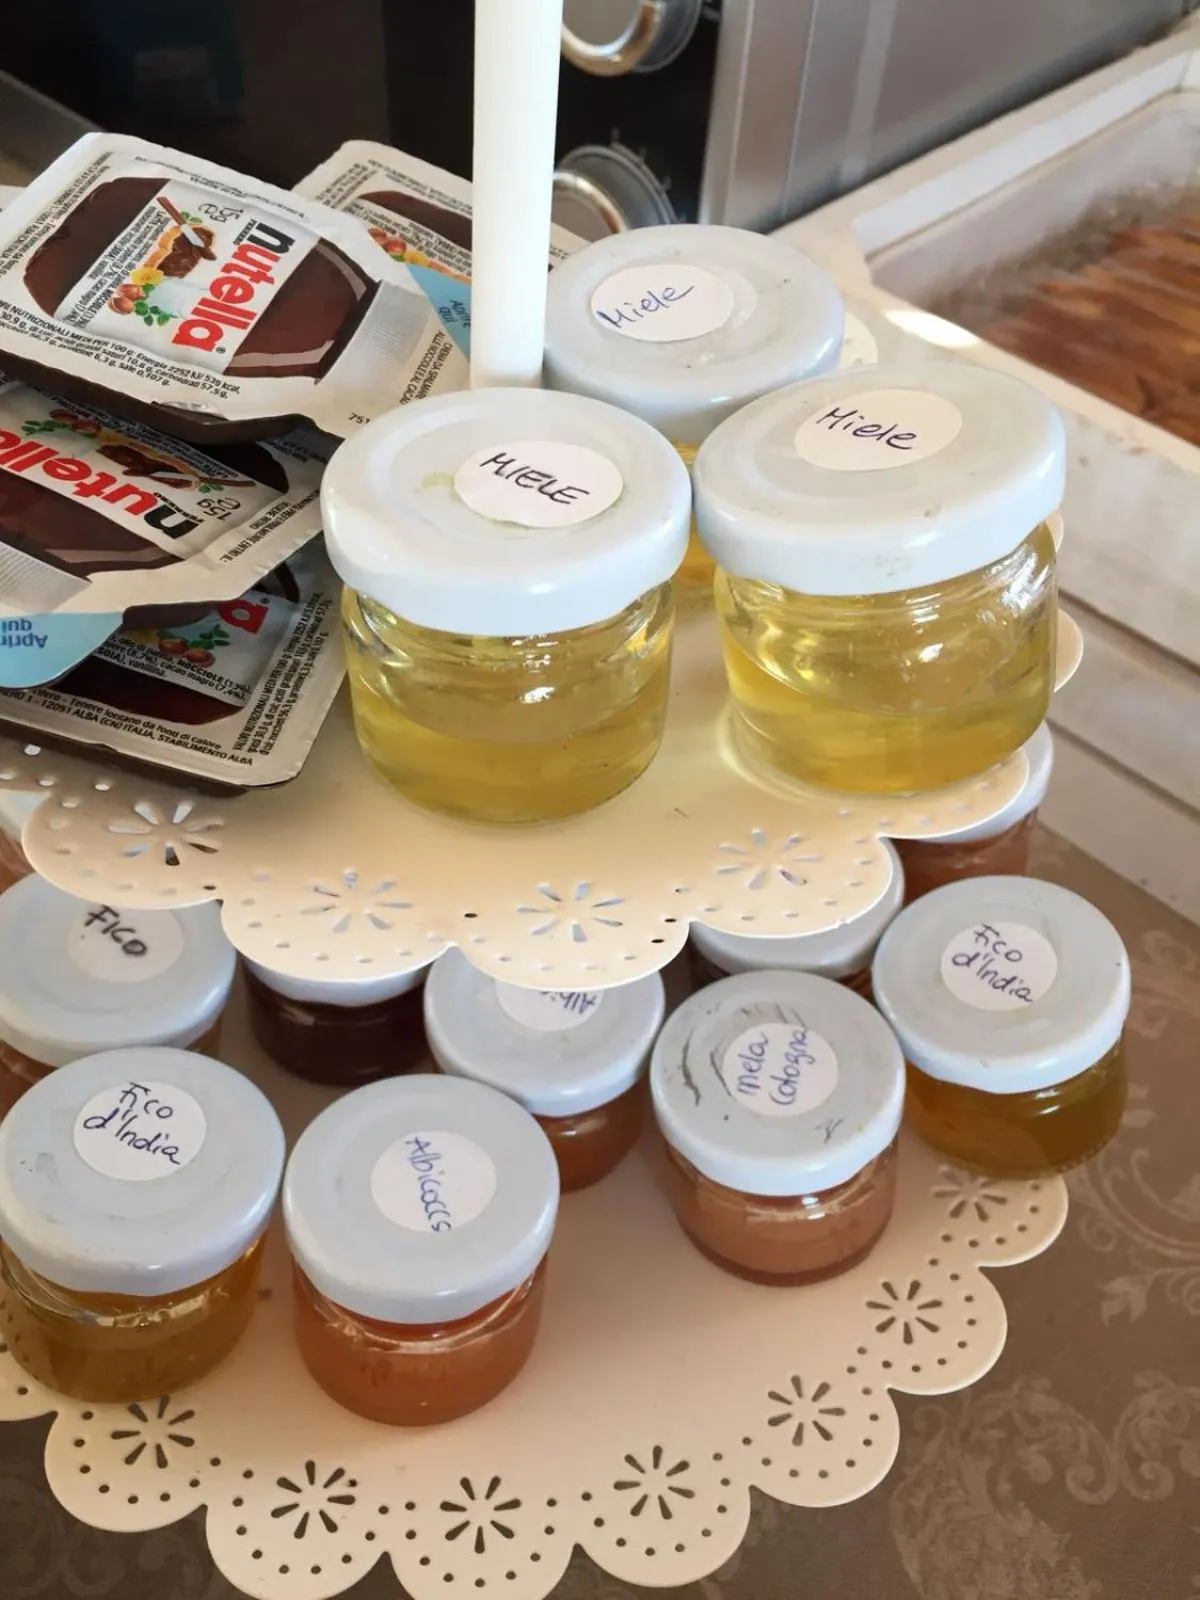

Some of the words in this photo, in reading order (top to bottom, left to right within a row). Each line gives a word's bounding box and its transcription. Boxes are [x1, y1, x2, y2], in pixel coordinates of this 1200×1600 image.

[171, 221, 297, 353] nutella
[597, 285, 695, 329] Miele
[815, 407, 917, 451] Miele
[479, 452, 590, 505] MIELE
[69, 697, 102, 713] Tenere
[141, 719, 155, 730] da
[190, 734, 222, 750] calore
[71, 707, 99, 722] ALBA
[157, 733, 228, 759] STABILIMENTO
[226, 752, 254, 766] ALBA
